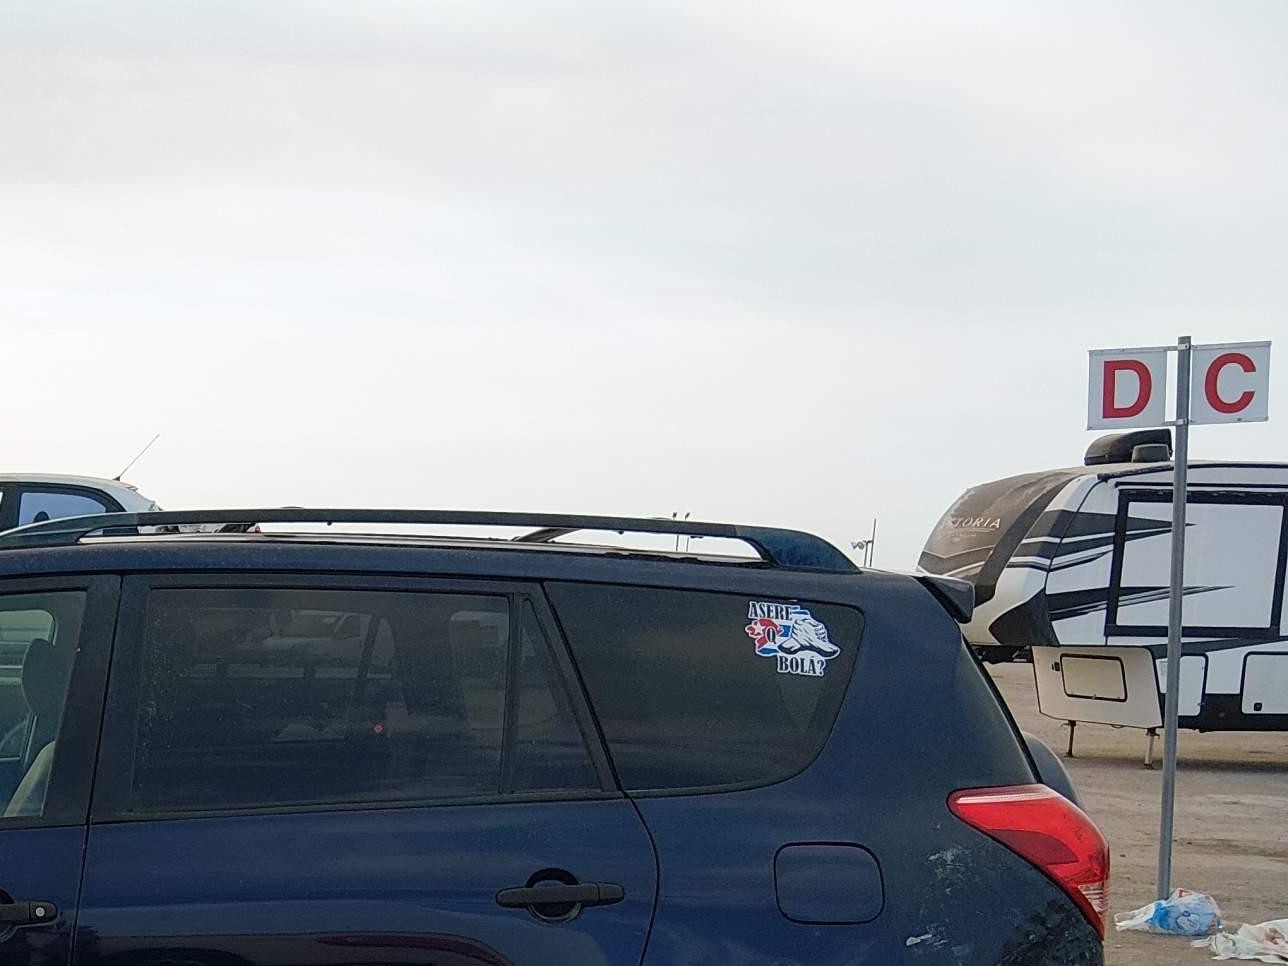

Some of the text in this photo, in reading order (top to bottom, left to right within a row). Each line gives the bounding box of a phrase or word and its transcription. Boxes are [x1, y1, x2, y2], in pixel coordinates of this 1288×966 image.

[1102, 360, 1152, 419] D
[1204, 352, 1257, 414] C
[749, 602, 793, 621] ASERE
[766, 628, 777, 645] Q
